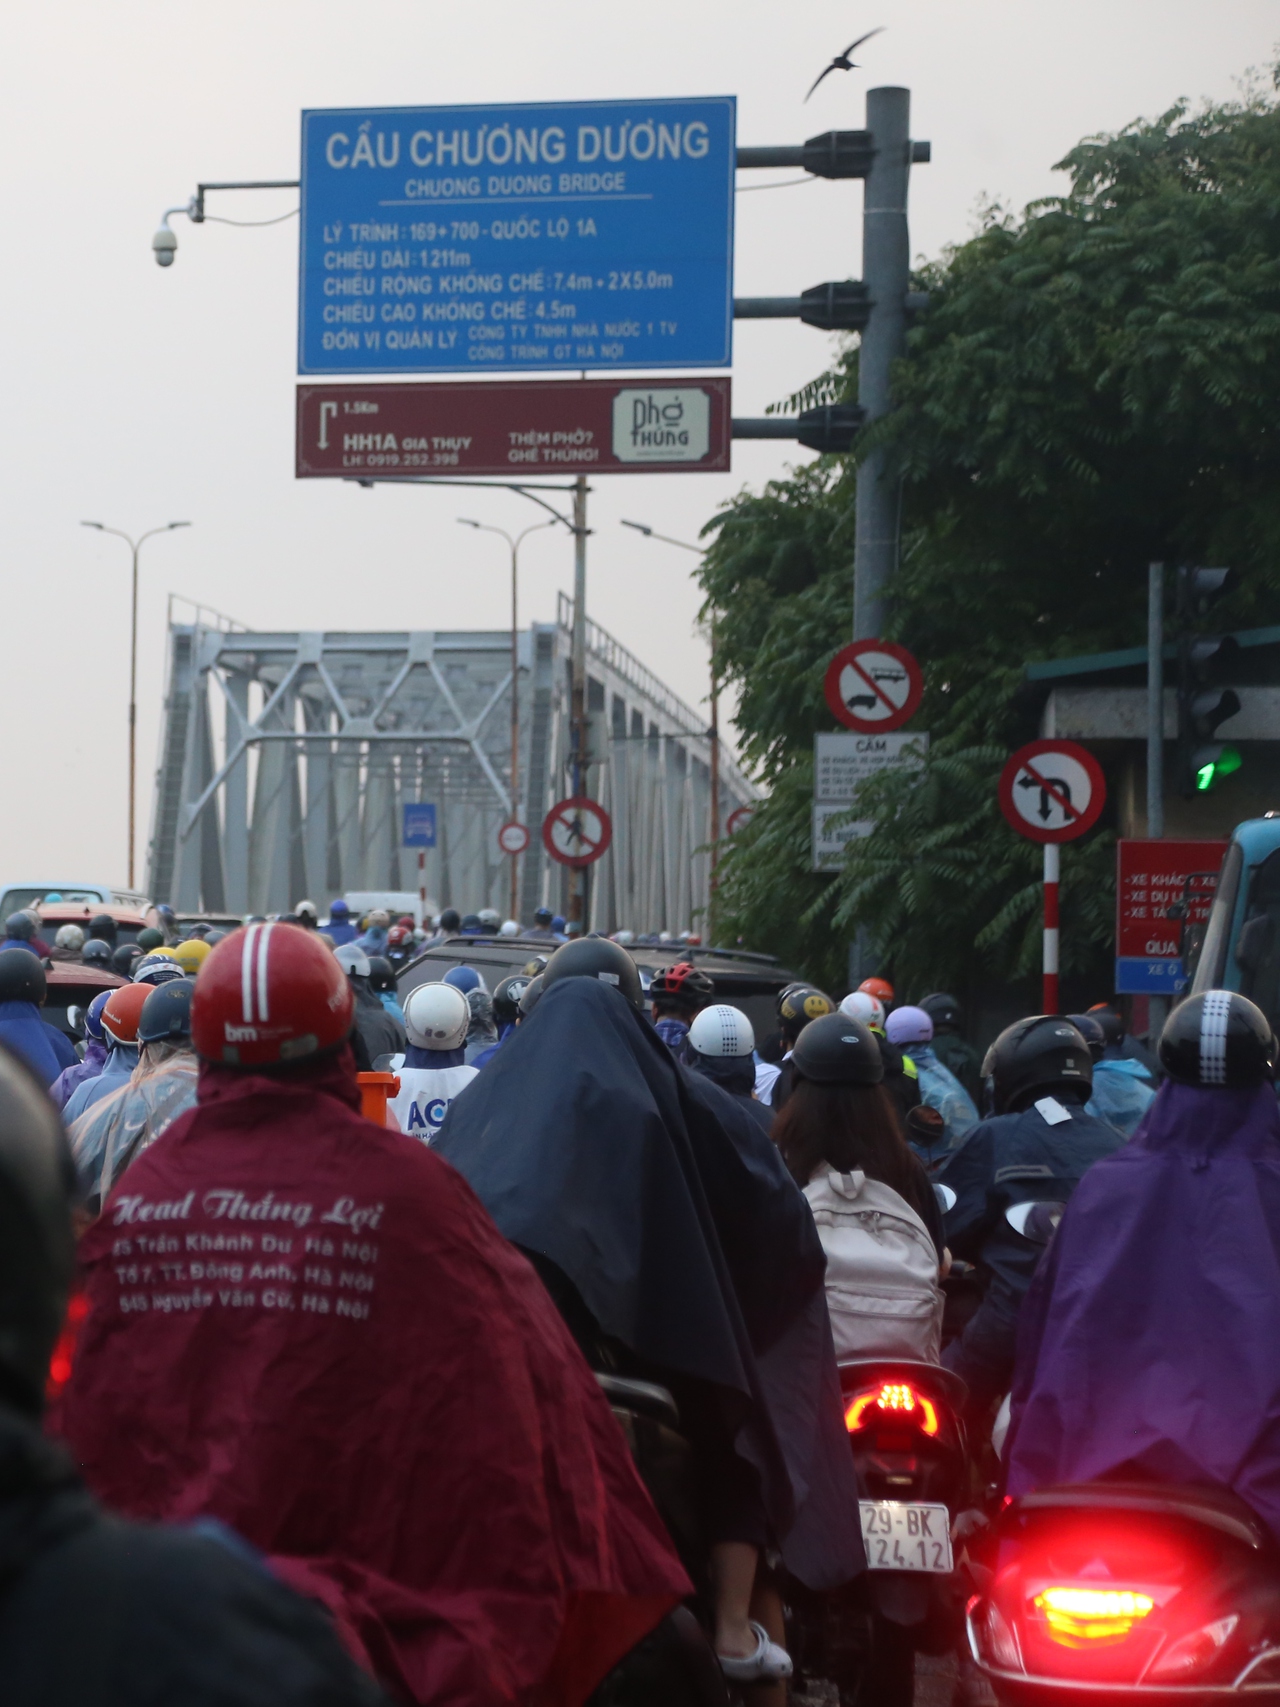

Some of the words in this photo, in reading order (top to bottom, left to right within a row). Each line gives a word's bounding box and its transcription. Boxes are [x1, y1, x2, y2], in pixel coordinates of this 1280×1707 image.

[410, 122, 566, 167] CHƯƠNG
[577, 117, 710, 162] DƯƠNG
[405, 177, 480, 198] CHUONG
[488, 175, 552, 196] DUONG
[559, 171, 626, 193] BRIDGE
[577, 217, 598, 237] 1A
[381, 302, 416, 322] CAO
[512, 323, 528, 339] TY
[343, 432, 398, 451] HH1A
[402, 437, 428, 450] GIA
[1147, 964, 1164, 976] XE
[865, 1507, 933, 1538] 29-BK
